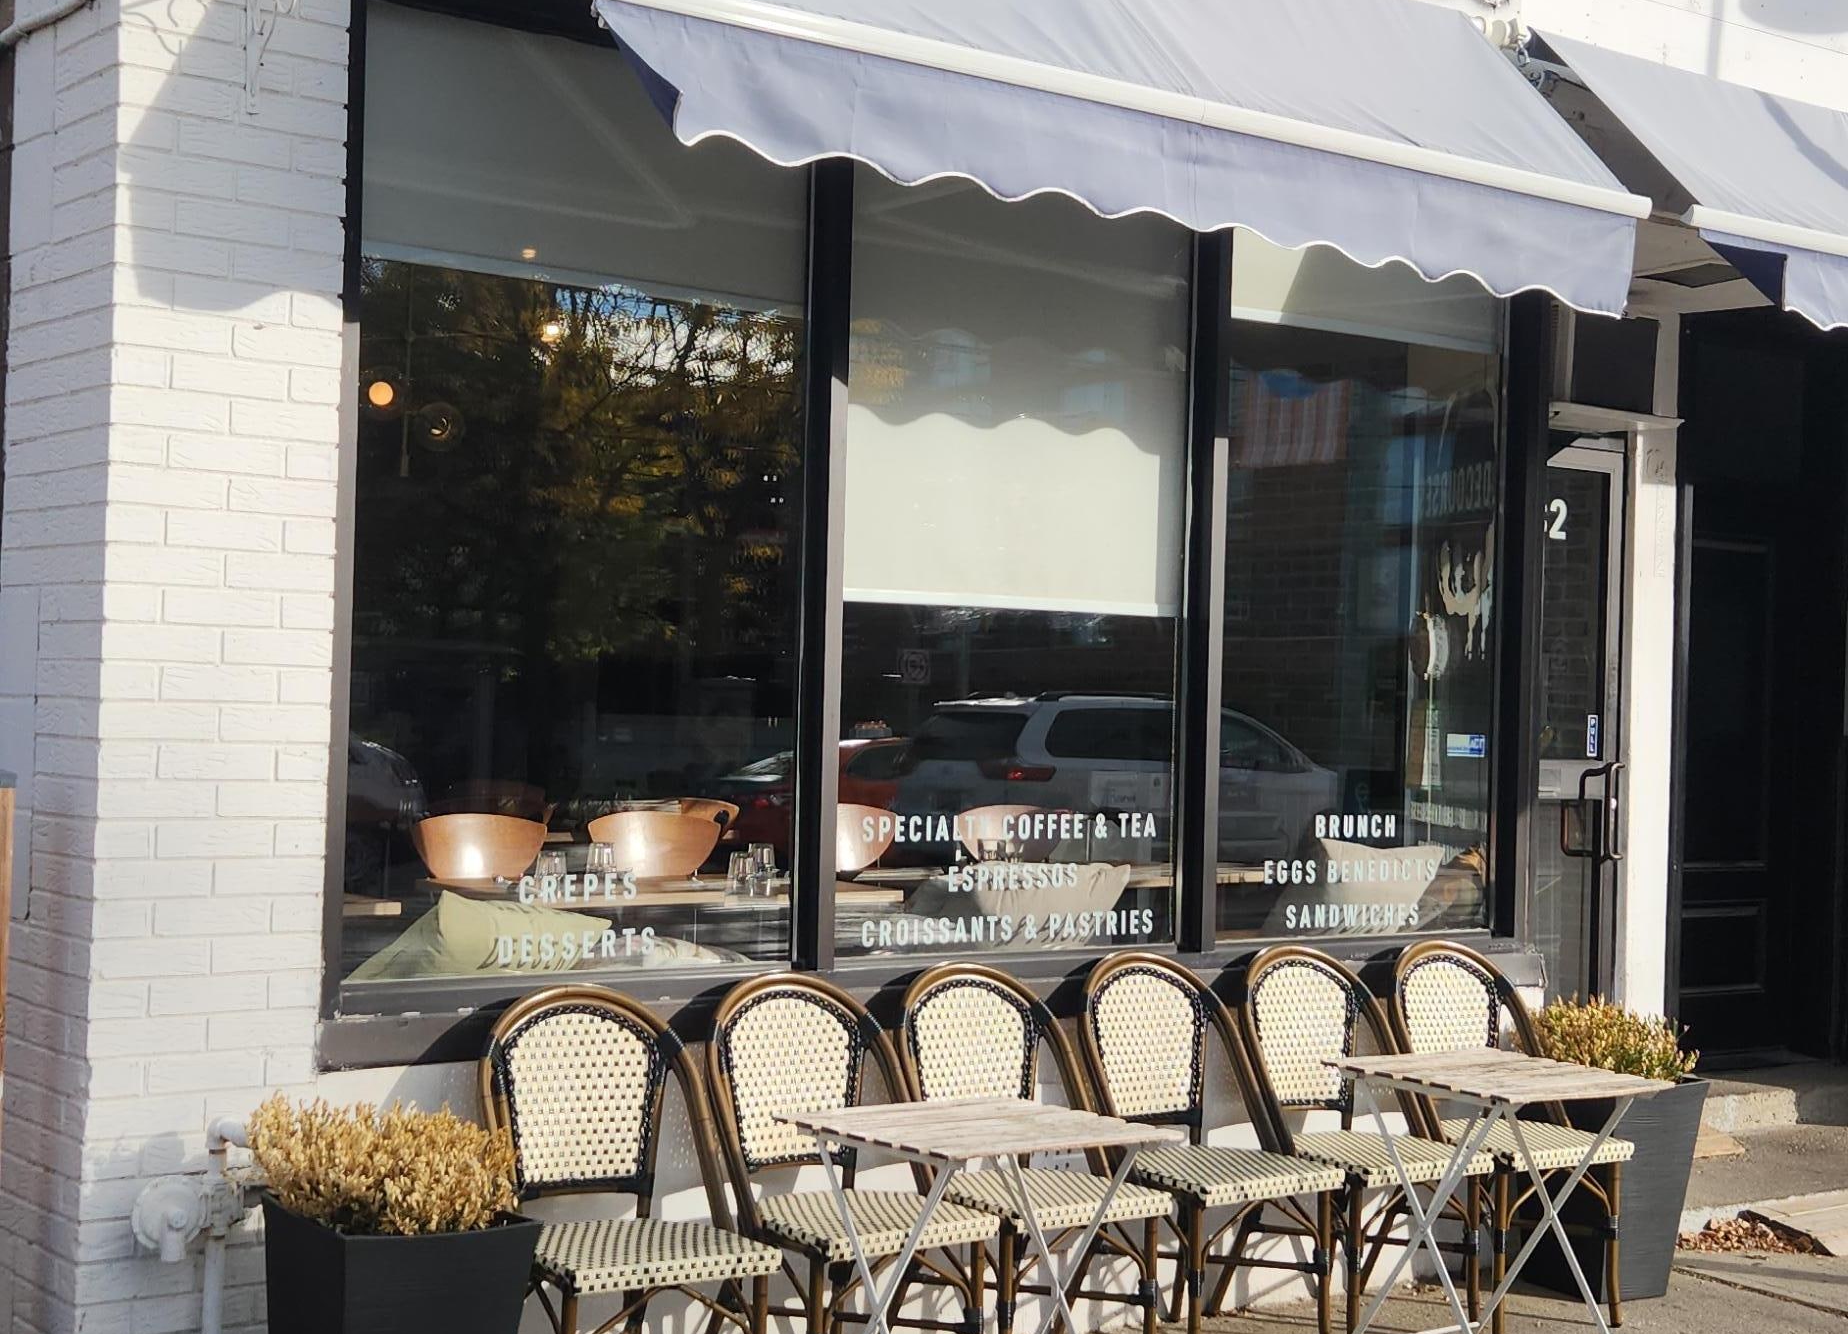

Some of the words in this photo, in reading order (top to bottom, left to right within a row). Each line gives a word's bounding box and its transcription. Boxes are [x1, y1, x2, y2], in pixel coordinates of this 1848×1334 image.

[1544, 499, 1568, 540] 2
[1002, 813, 1084, 841] COFFEE
[1094, 813, 1108, 839] &
[1118, 812, 1157, 838] TEA
[1315, 814, 1396, 838] BRUNCH
[949, 863, 1078, 892] ESPRESSOS
[1264, 860, 1317, 884] EGGS
[1327, 858, 1437, 884] BENEDICTS
[518, 873, 639, 905] CREPES
[861, 915, 1012, 947] CROISSANTS
[1024, 914, 1038, 939] &
[1049, 908, 1154, 939] PASTRIES
[1285, 903, 1420, 929] SANDWICHES
[498, 927, 656, 964] DESSERTS
